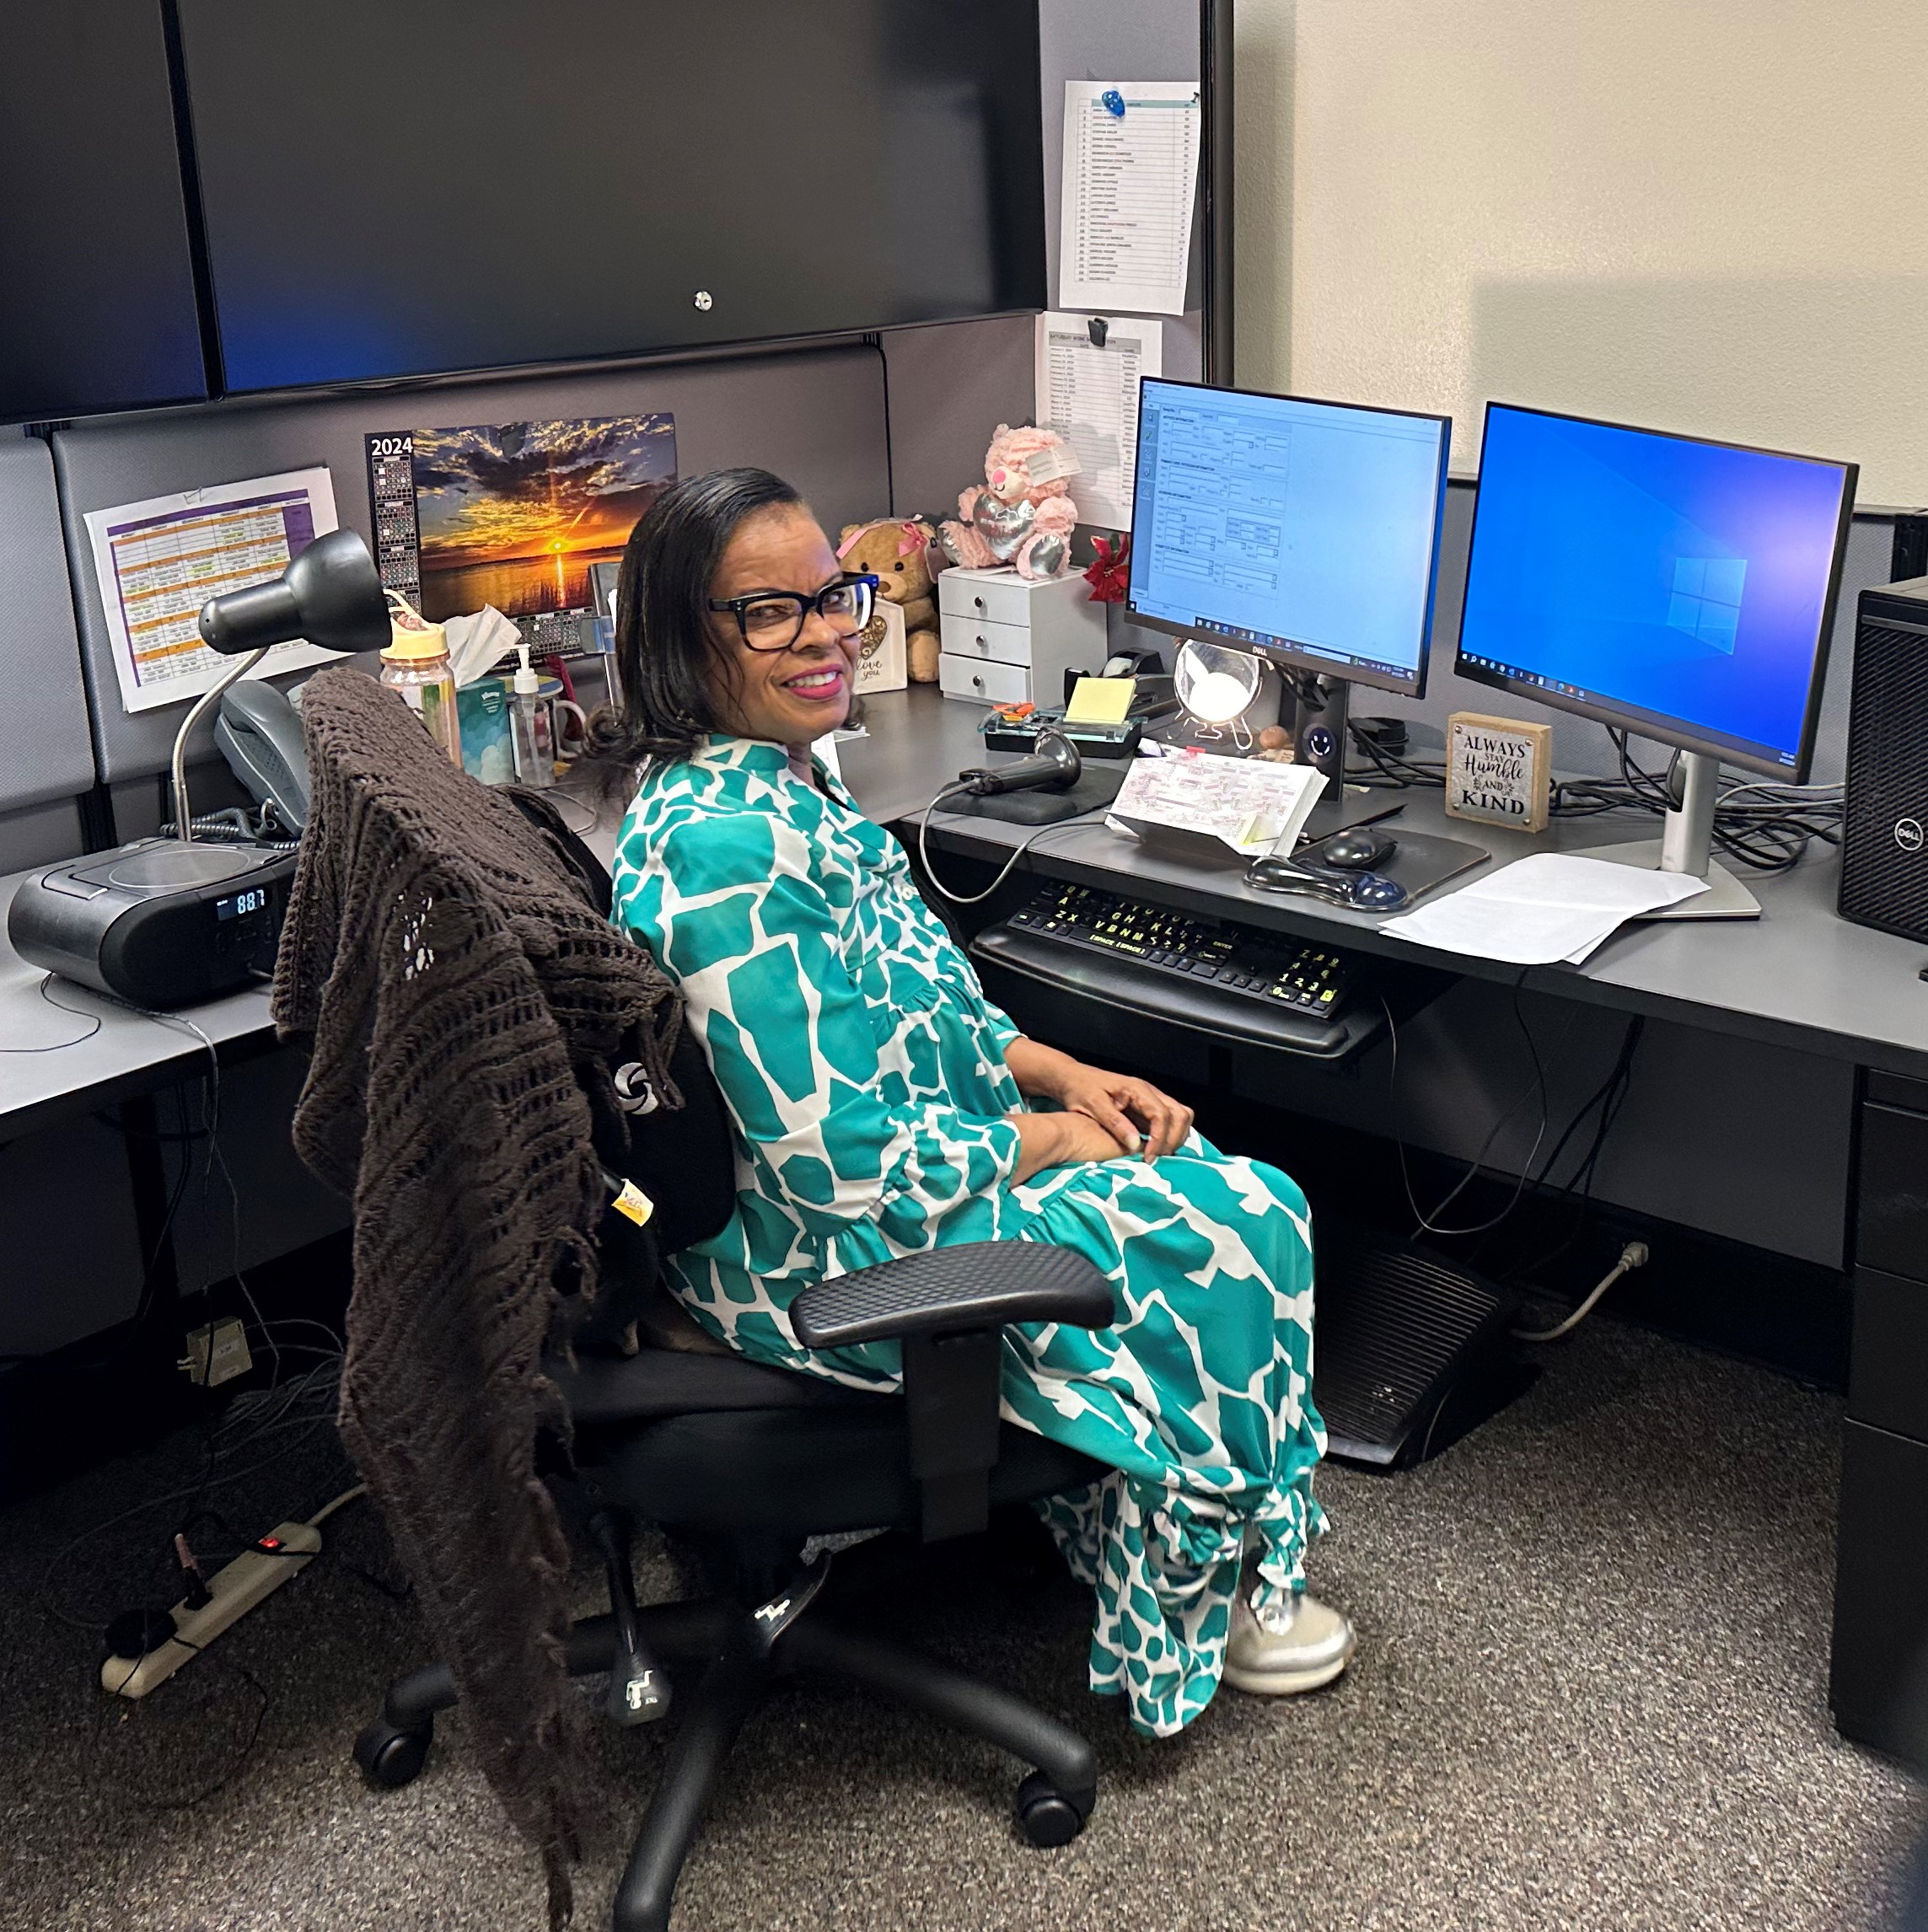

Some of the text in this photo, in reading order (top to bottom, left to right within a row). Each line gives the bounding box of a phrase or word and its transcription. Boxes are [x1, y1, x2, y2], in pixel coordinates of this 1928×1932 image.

[372, 437, 413, 456] 2024
[1253, 646, 1267, 656] DELL
[857, 657, 882, 671] love
[862, 669, 880, 681] you
[1464, 734, 1526, 758] ALWAYS
[1485, 752, 1506, 763] STAY
[1464, 753, 1524, 781] Humble
[1483, 780, 1503, 791] AND
[1462, 789, 1525, 815] KIND
[1898, 829, 1921, 840] DELL
[1059, 897, 1068, 905] A
[1112, 912, 1122, 920] G
[1124, 915, 1136, 923] H
[1151, 922, 1162, 931] K
[1055, 910, 1067, 919] Z
[1067, 914, 1079, 922] X
[1095, 920, 1105, 929] V
[1107, 925, 1118, 933] B
[1120, 928, 1131, 937] N
